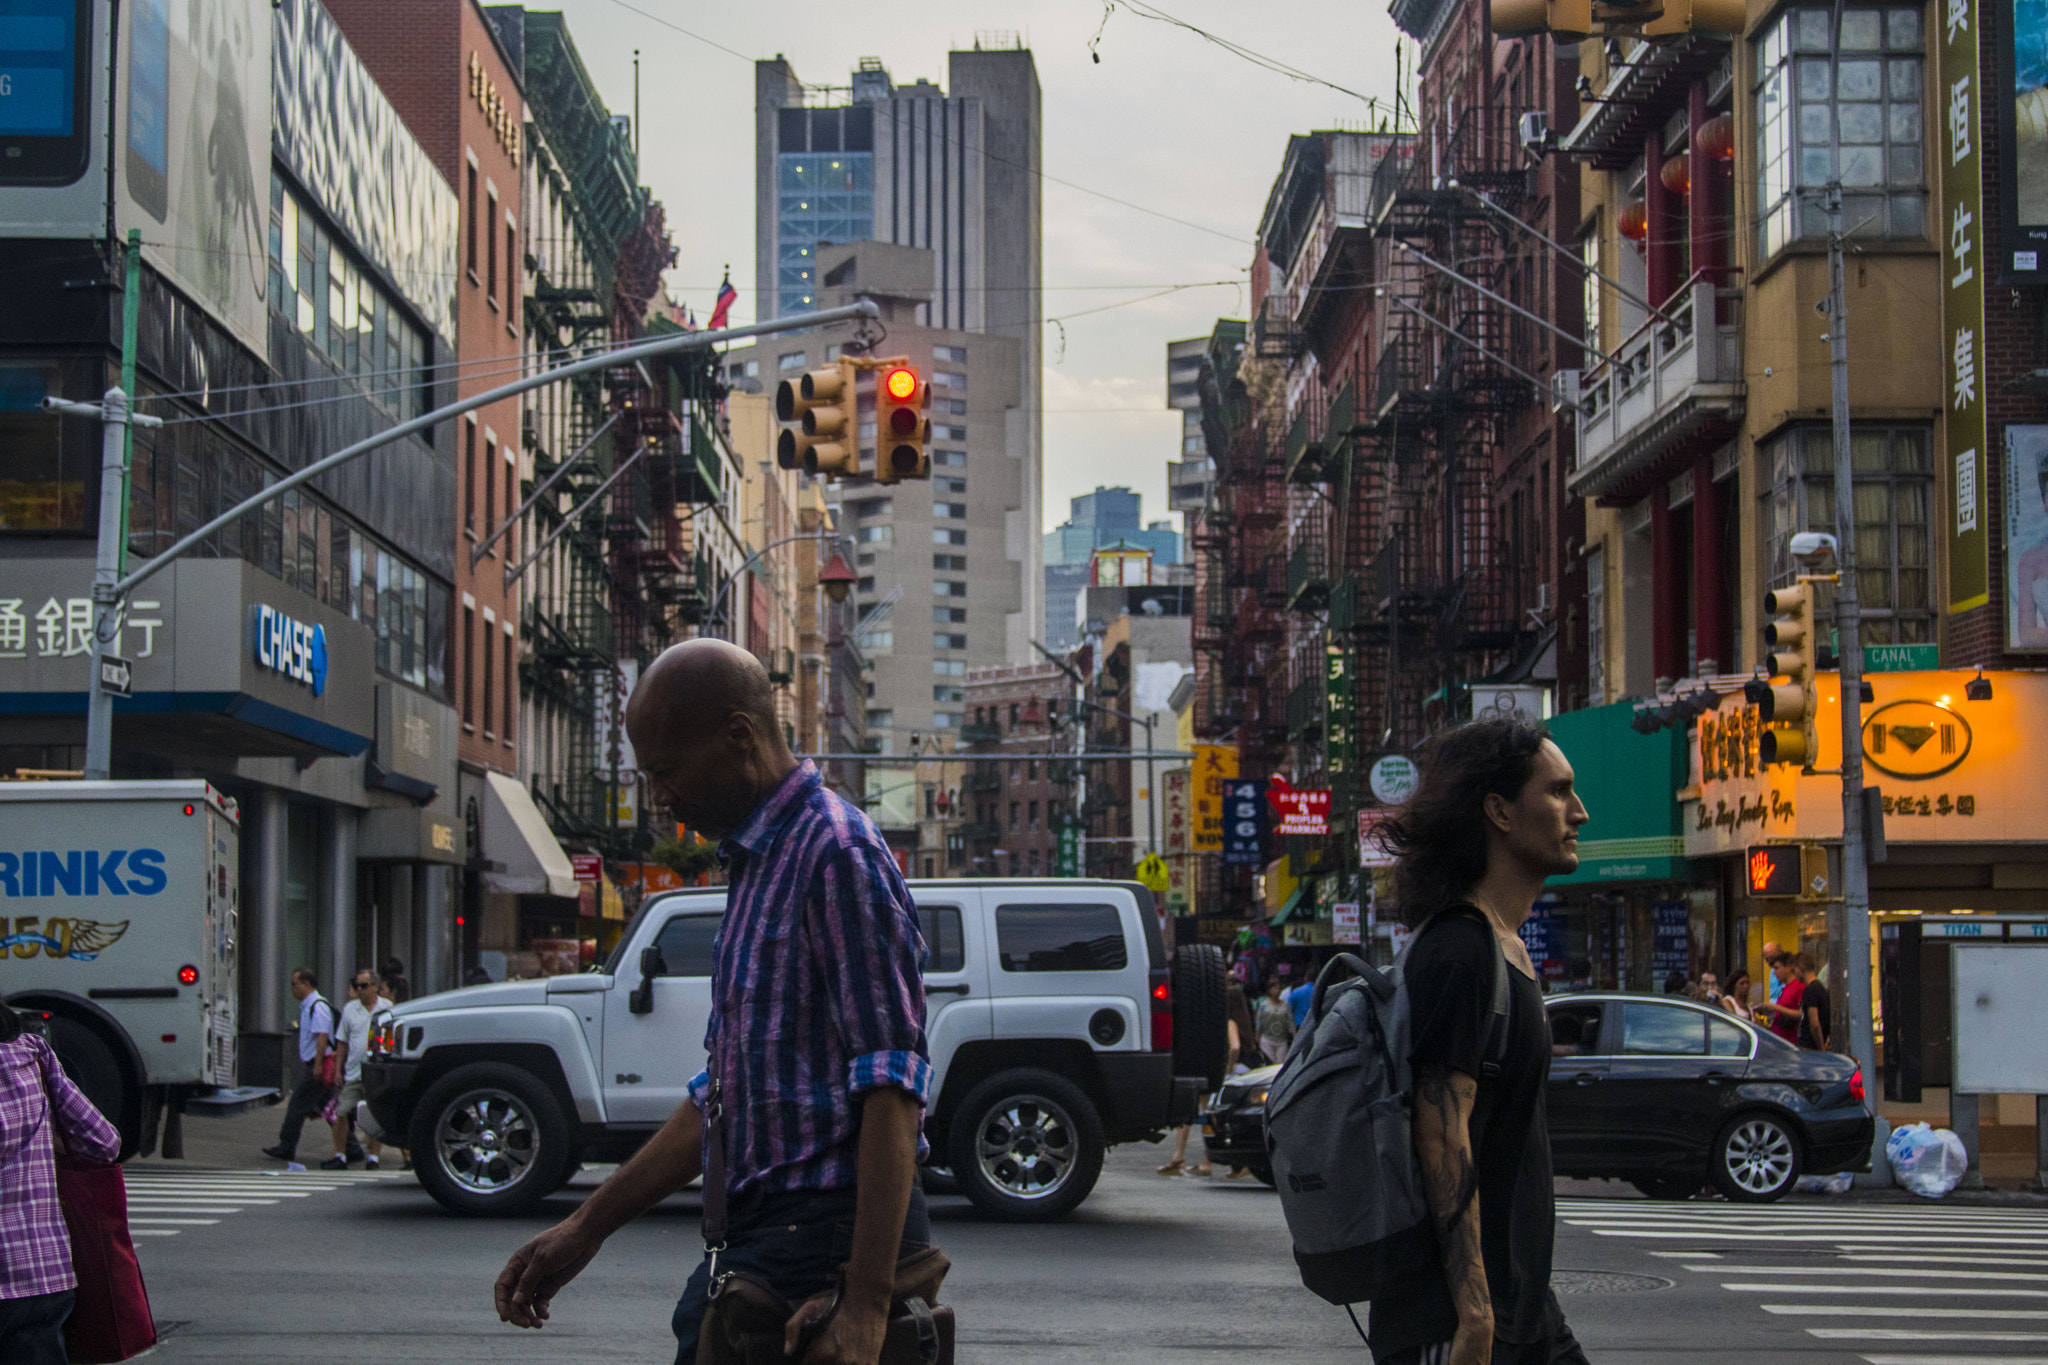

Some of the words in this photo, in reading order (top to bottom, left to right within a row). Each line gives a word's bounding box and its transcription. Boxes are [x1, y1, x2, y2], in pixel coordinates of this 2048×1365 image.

[2029, 231, 2047, 240] Kung
[258, 603, 314, 684] CHASE
[1872, 648, 1914, 663] CANAL
[1280, 824, 1329, 835] PHARMACY
[1943, 924, 1982, 936] TITAN
